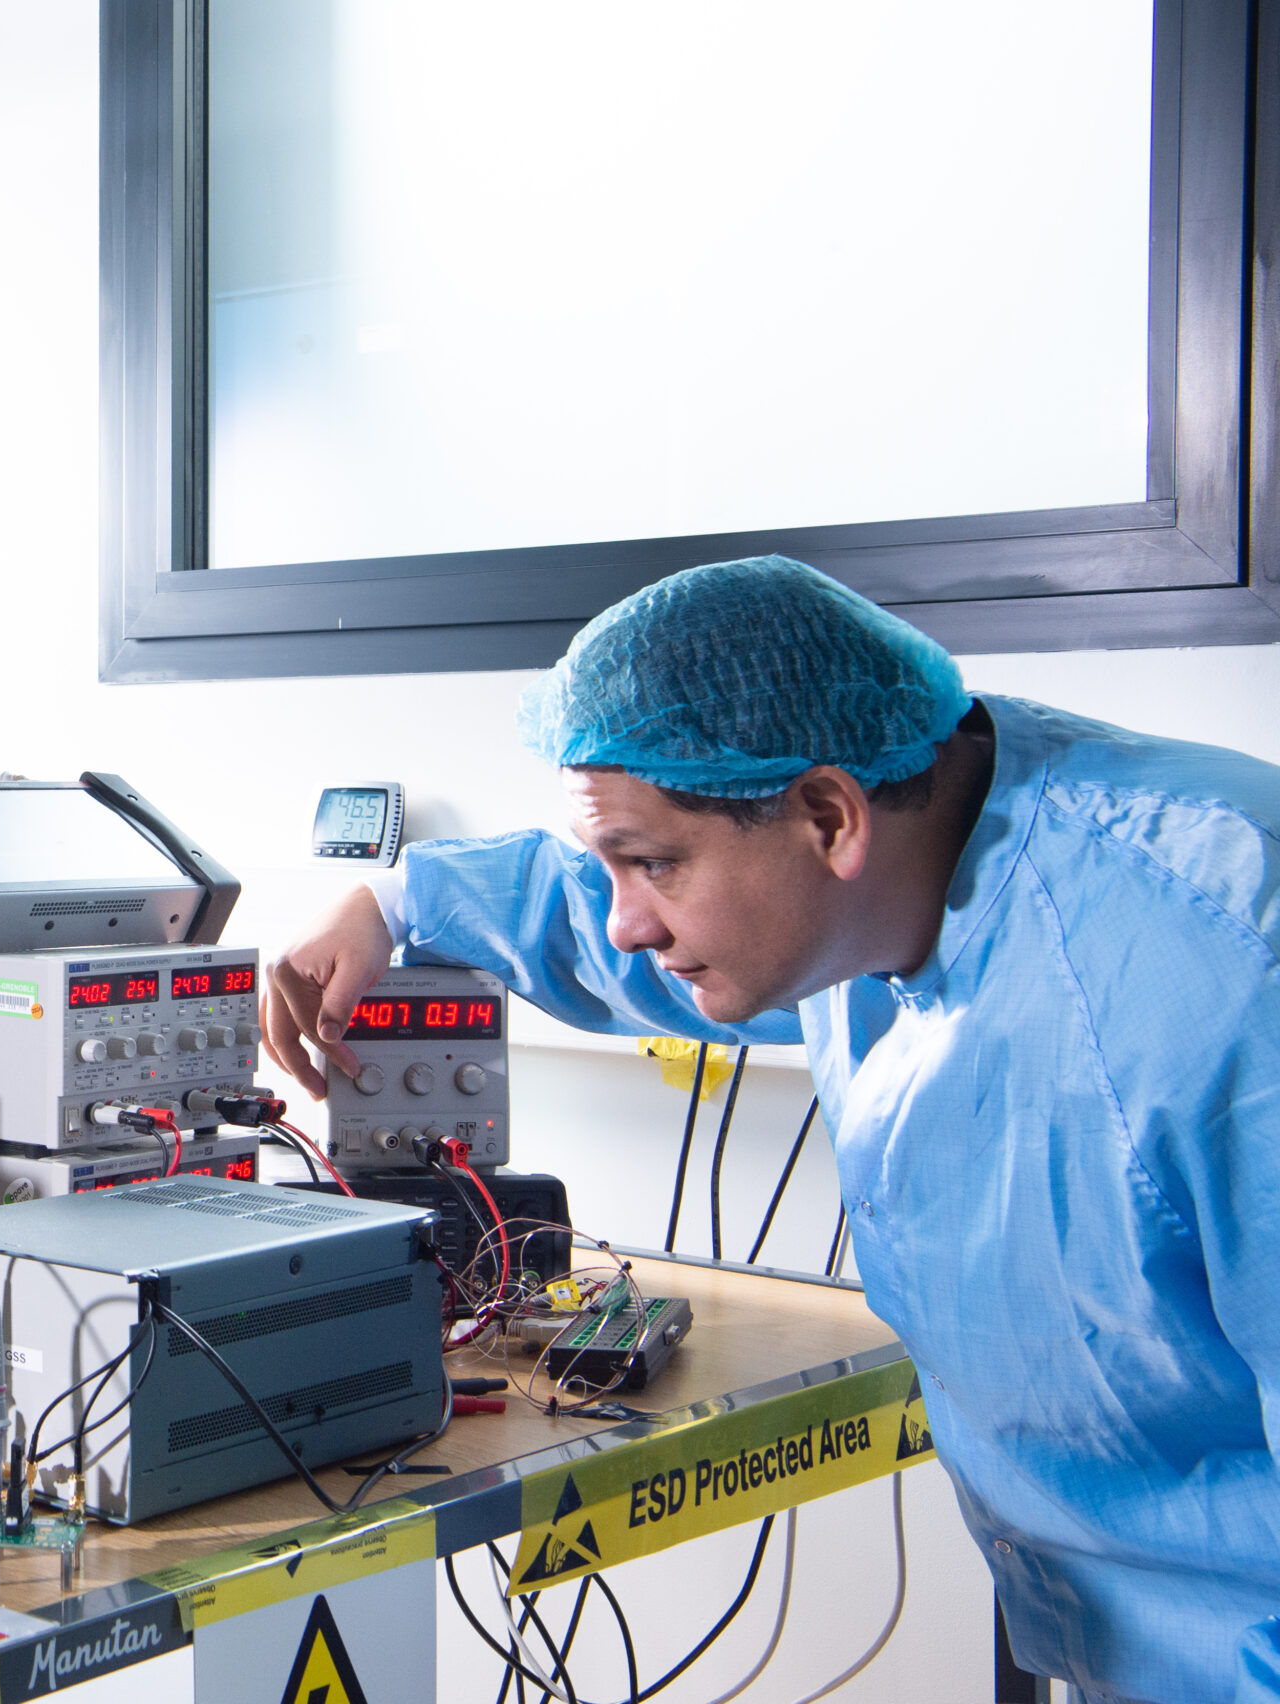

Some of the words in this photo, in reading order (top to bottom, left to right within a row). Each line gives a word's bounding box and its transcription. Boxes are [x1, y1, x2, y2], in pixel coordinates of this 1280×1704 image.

[126, 979, 156, 999] 254
[225, 971, 252, 991] 323
[629, 1467, 686, 1529] ESD
[695, 1424, 814, 1506] Protected
[819, 1416, 872, 1464] Area
[28, 1618, 163, 1691] Manutan
